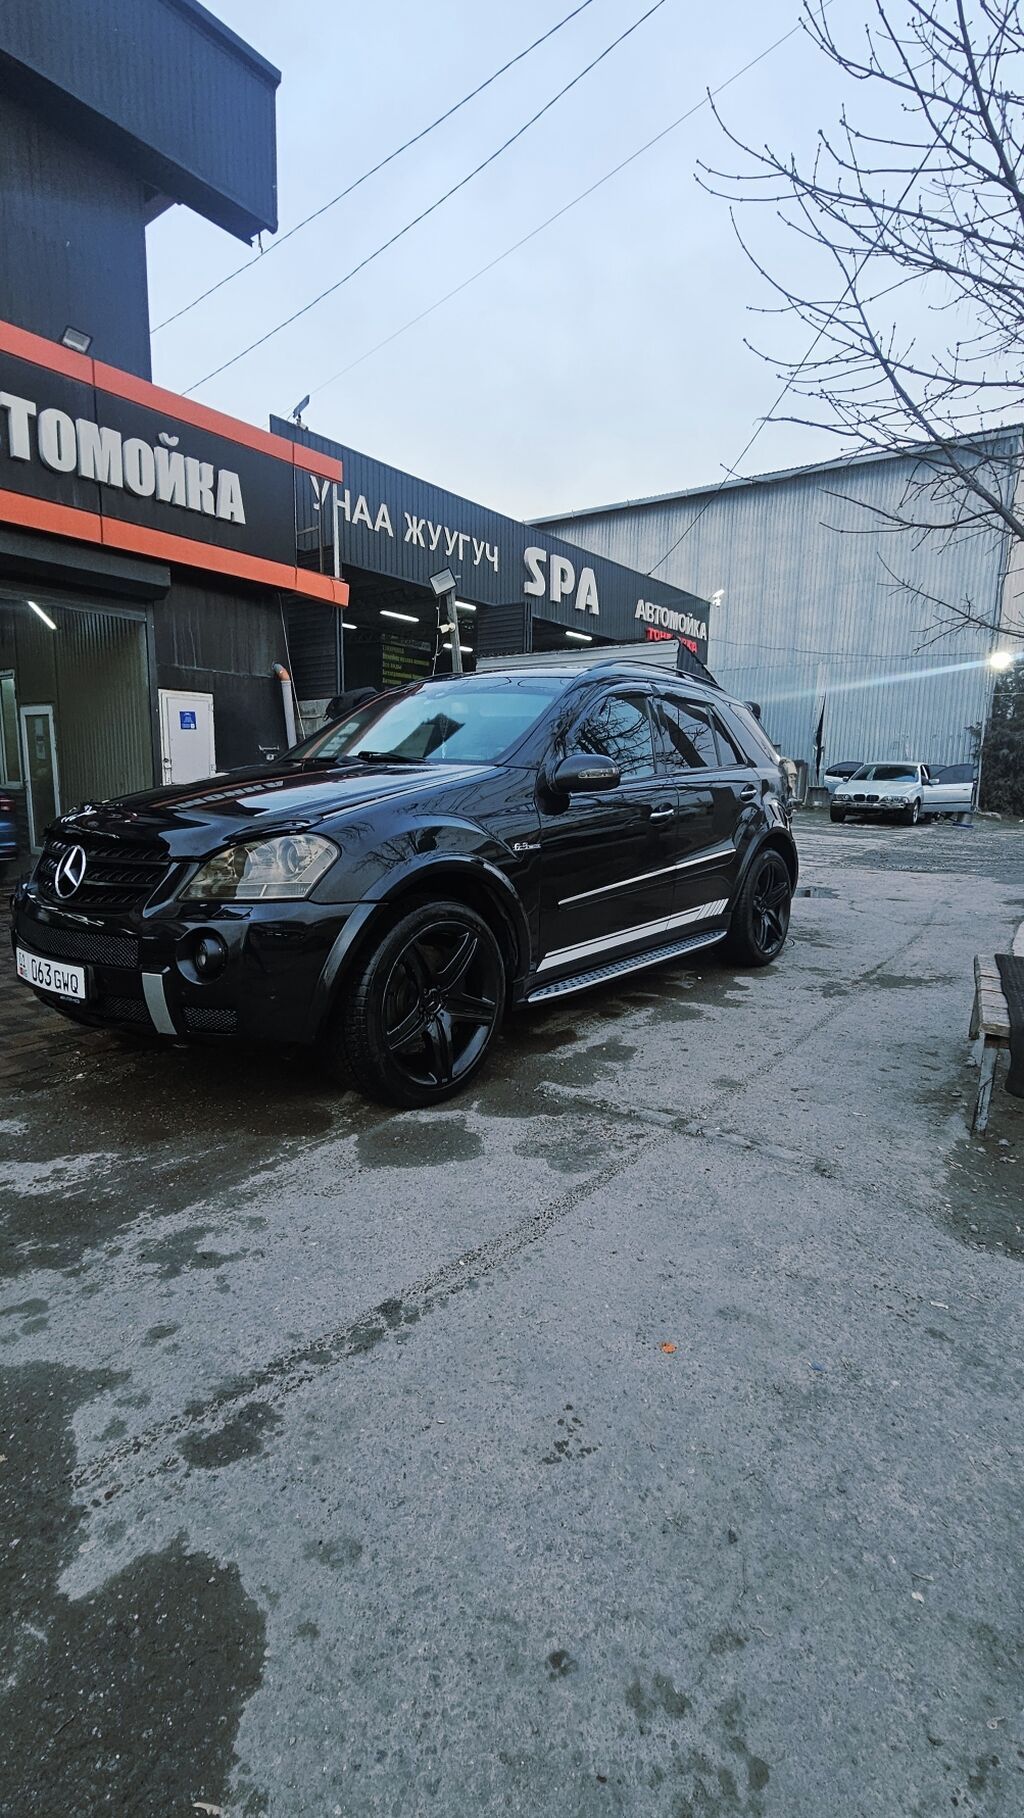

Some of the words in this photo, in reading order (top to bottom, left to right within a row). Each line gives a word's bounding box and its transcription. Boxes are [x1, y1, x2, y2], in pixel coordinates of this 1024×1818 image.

[0, 391, 246, 525] ТОМОЙКА
[310, 475, 394, 537] УНАА
[404, 512, 499, 572] ЖУУГУЧ
[523, 546, 600, 616] SPA
[635, 599, 707, 641] АВТОМОЙКА
